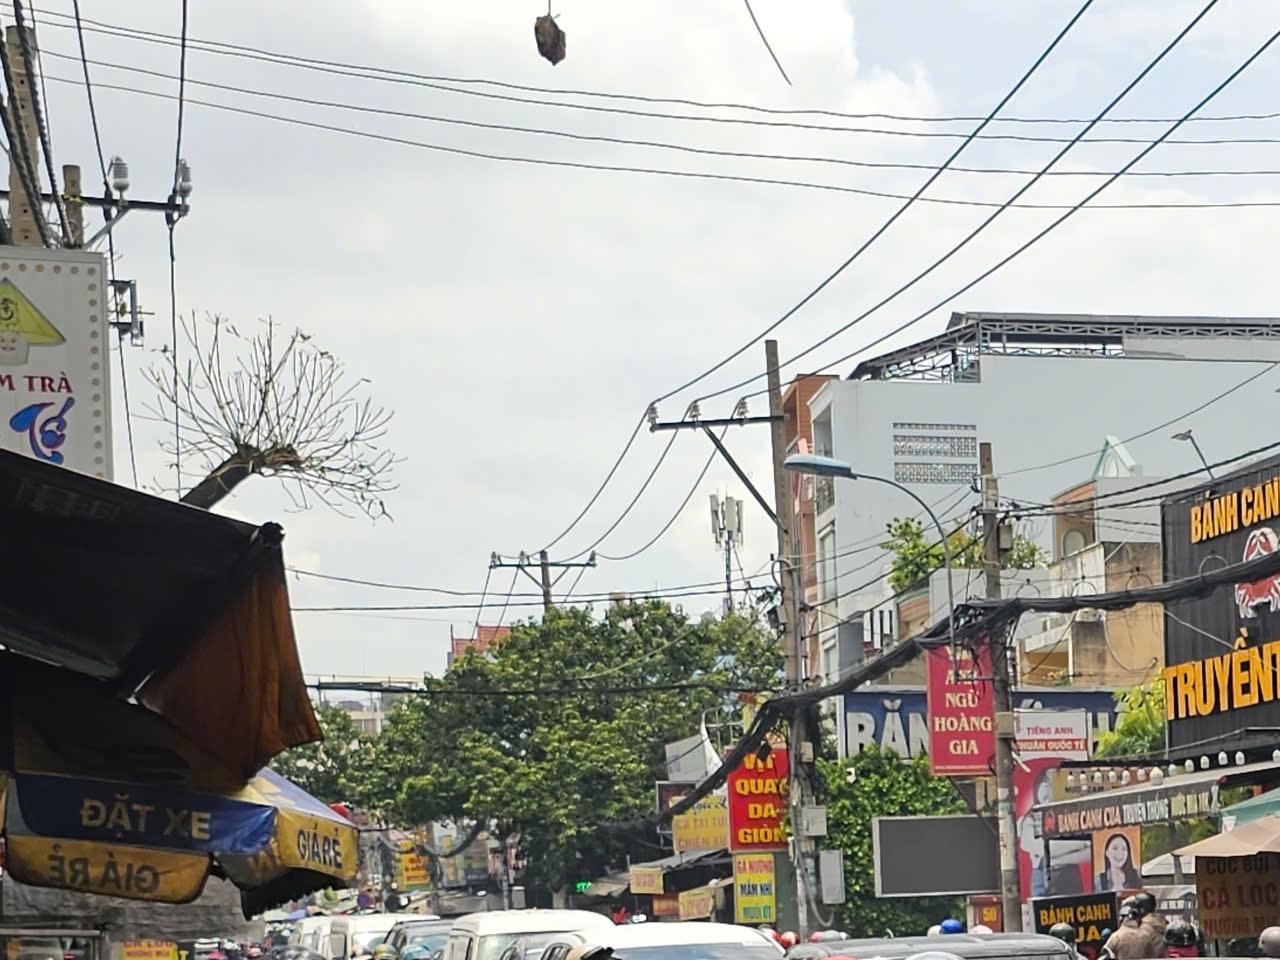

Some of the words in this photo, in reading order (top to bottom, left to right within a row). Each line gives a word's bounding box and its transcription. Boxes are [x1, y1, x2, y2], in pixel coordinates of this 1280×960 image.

[24, 372, 73, 393] TRÀ
[1190, 490, 1238, 544] BÁNH
[1163, 627, 1272, 720] TRUYỀN
[934, 713, 993, 732] HOÀNG
[1026, 722, 1051, 736] TIẾNG
[1053, 725, 1073, 736] ANH
[949, 739, 979, 755] GIA
[1047, 737, 1073, 752] QUỐC
[1074, 736, 1087, 751] TẾ
[81, 794, 154, 839] ĐẶT
[164, 808, 211, 840] XE
[749, 803, 777, 819] DA
[1104, 805, 1121, 826] CUA
[1040, 906, 1074, 926] BÁNH
[1077, 903, 1111, 922] CANH
[1073, 926, 1101, 942] UA
